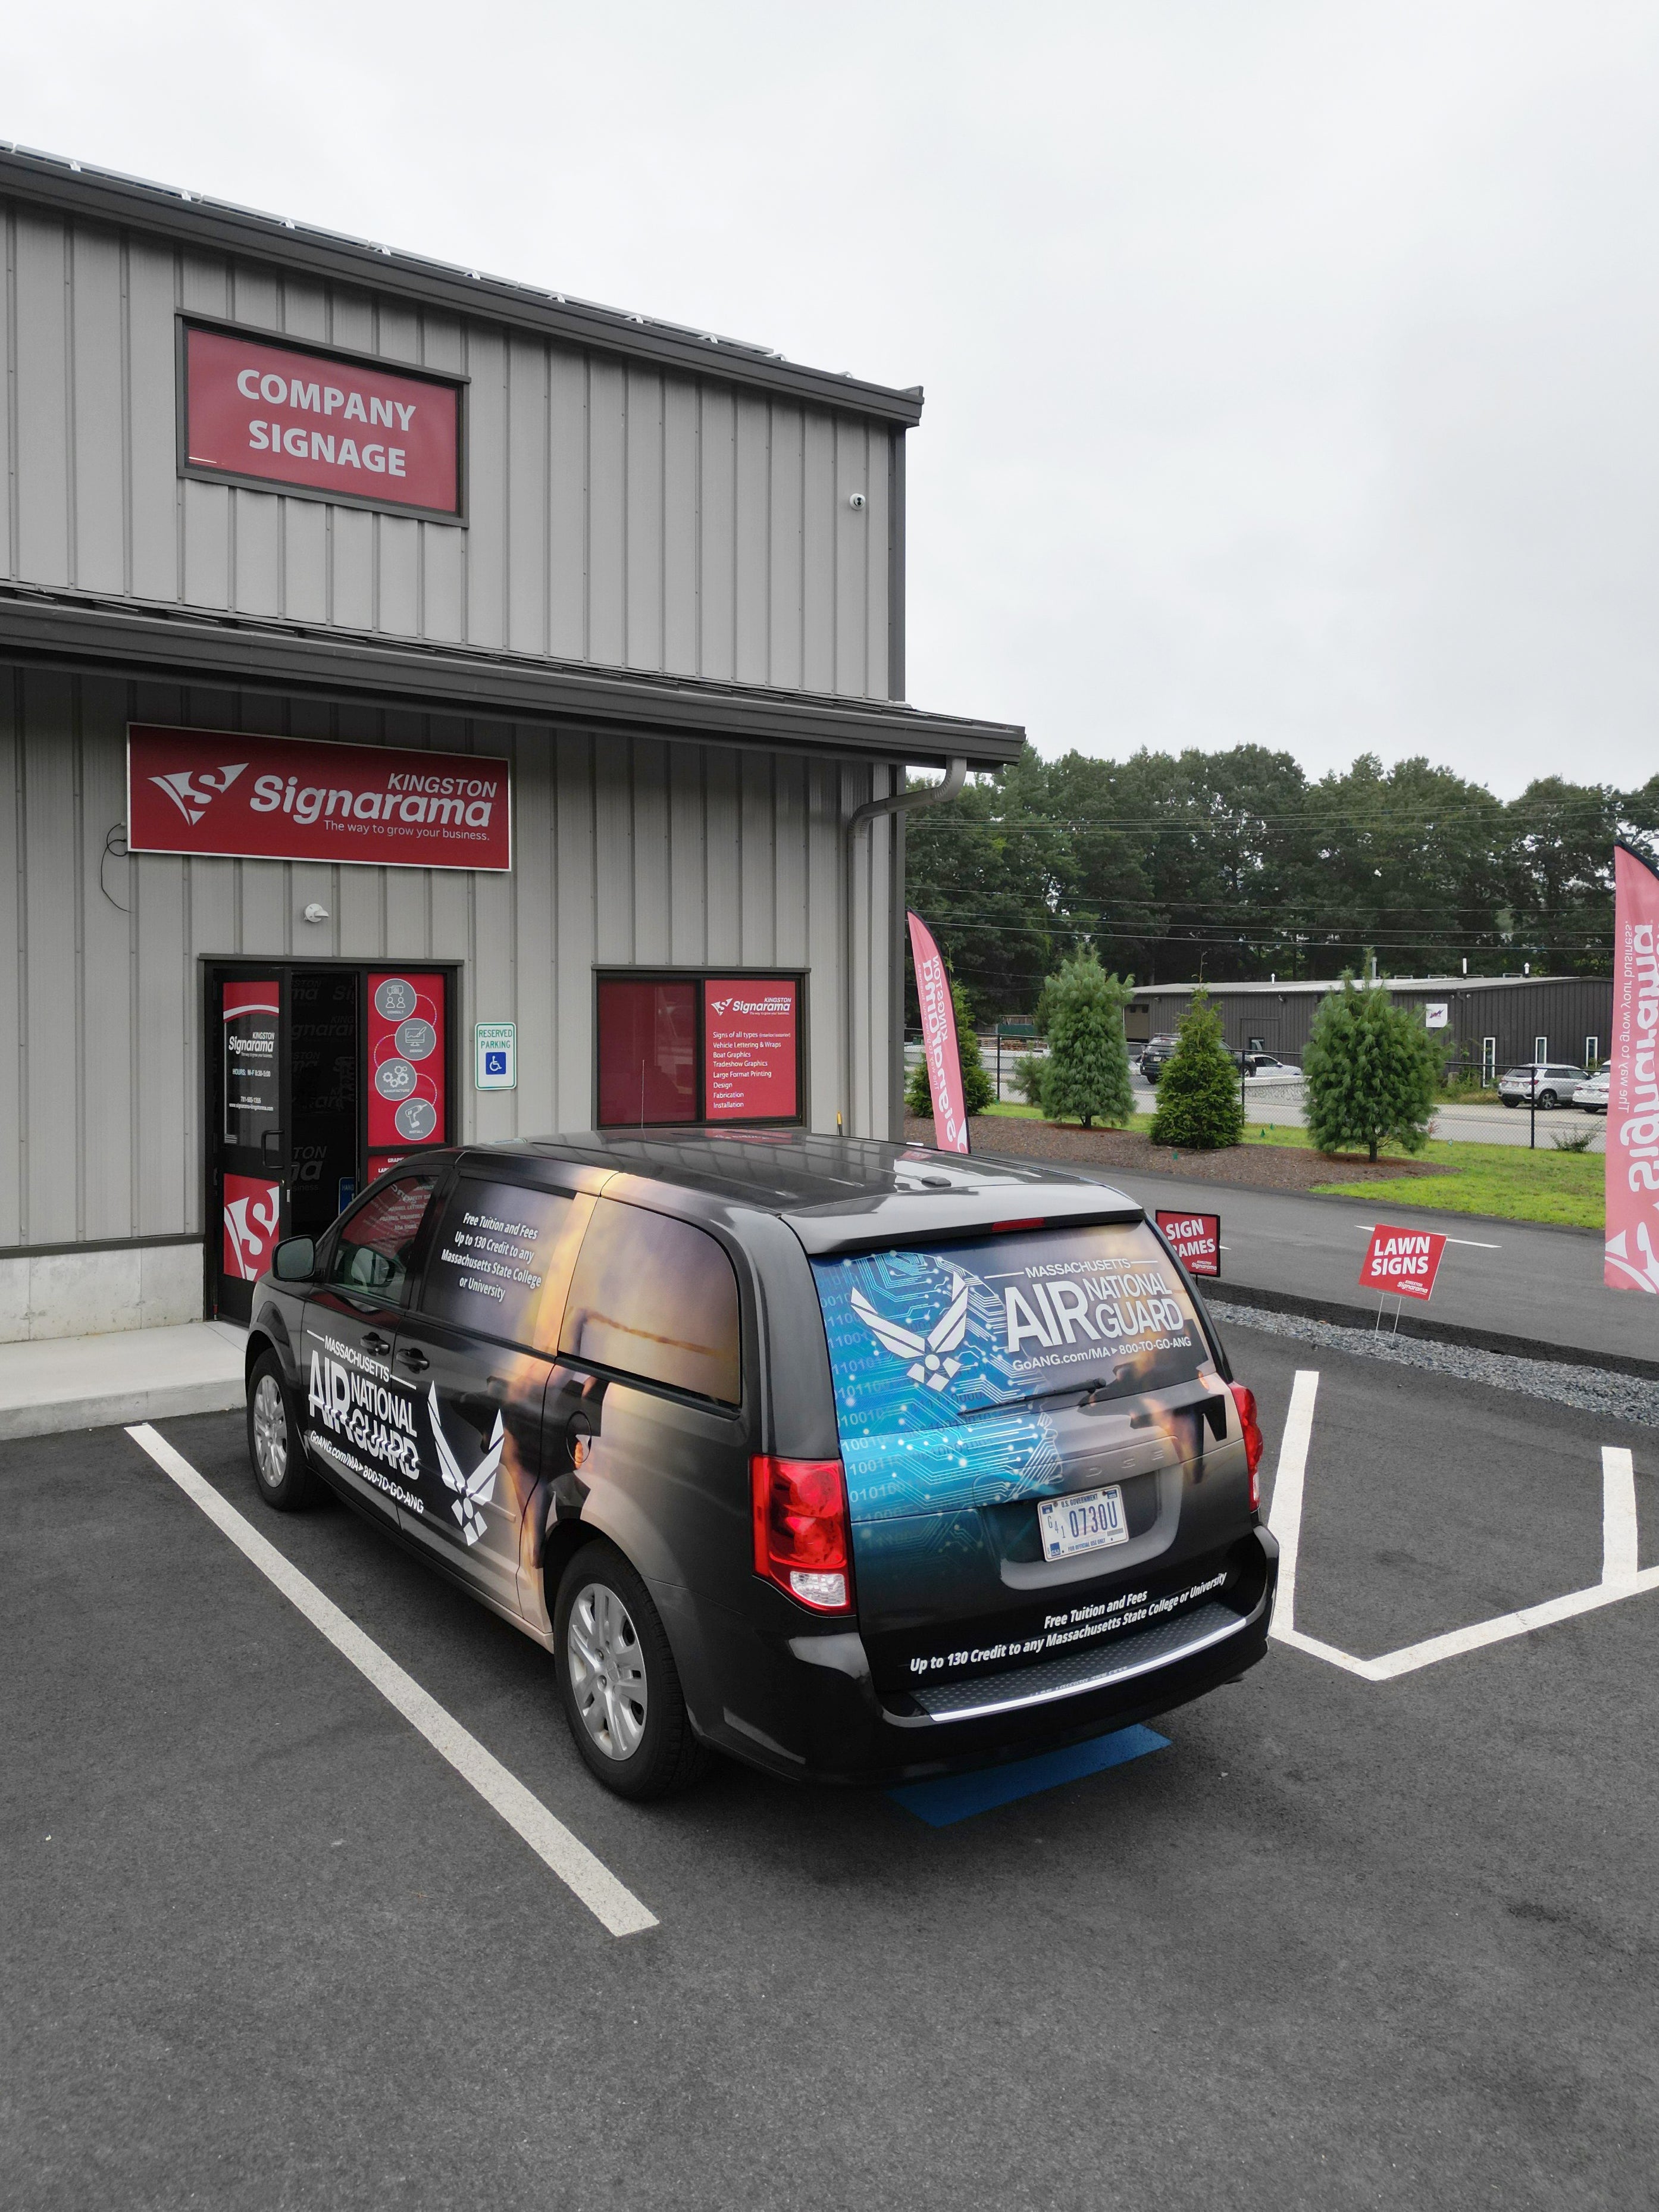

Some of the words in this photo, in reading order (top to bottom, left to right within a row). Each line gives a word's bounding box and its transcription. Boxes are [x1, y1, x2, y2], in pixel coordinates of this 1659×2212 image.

[237, 369, 417, 431] COMPANY
[249, 420, 406, 477] SIGNAGE
[249, 775, 494, 827] Signarama
[387, 772, 497, 798] KINGSTON
[324, 820, 345, 831] The
[348, 824, 370, 835] way
[373, 825, 384, 833] to
[387, 826, 414, 837] grow
[416, 829, 440, 838] your
[443, 828, 490, 840] business.
[733, 1000, 790, 1014] Signarama
[228, 1036, 274, 1054] Signarama
[463, 1212, 478, 1226] Free
[480, 1216, 505, 1232] Tuition
[504, 1223, 521, 1235] and
[519, 1224, 539, 1240] Fees
[1166, 1219, 1204, 1240] SIGN
[455, 1231, 466, 1247] Up
[465, 1234, 473, 1246] to
[474, 1235, 487, 1249] 130
[487, 1239, 509, 1255] Credit
[510, 1244, 518, 1257] to
[518, 1249, 534, 1265] any
[1172, 1238, 1215, 1257] AMES
[1374, 1237, 1431, 1256] LAWN
[441, 1249, 492, 1273] Massachusetts
[492, 1262, 512, 1278] State
[513, 1268, 542, 1290] College
[1025, 1258, 1131, 1278] MASSACHUSETTS
[1371, 1256, 1429, 1276] SIGNS
[459, 1277, 468, 1288] or
[468, 1277, 506, 1303] University
[1082, 1273, 1173, 1301] NATIONAL
[1004, 1281, 1101, 1353] AIR
[1095, 1298, 1184, 1338] GUARD
[324, 1335, 390, 1382] MASSACHUSETTS
[1012, 1346, 1110, 1372] GoANG.com/MA
[1119, 1337, 1192, 1355] 800-TO-GO-ANG
[308, 1350, 355, 1443] AIR
[351, 1372, 417, 1438] NATIONAL
[350, 1409, 420, 1480] GUARD
[310, 1430, 359, 1471] GoANG.com/MA
[362, 1465, 424, 1514] 800-TO-GO-ANG
[1070, 1494, 1098, 1506] GOVERNMENT
[1069, 1501, 1118, 1538] 0730U
[910, 1658, 928, 1674] Up
[931, 1657, 944, 1669] to
[947, 1651, 968, 1666] 130
[971, 1644, 1007, 1663] Credit
[1009, 1643, 1021, 1656] to
[1023, 1638, 1045, 1653] any
[1046, 1616, 1122, 1647] Massachusetts
[1122, 1609, 1147, 1626] State
[1148, 1595, 1179, 1616] College
[1179, 1591, 1190, 1603] or
[1190, 1572, 1228, 1598] University
[1044, 1615, 1067, 1629] Free
[1070, 1604, 1105, 1623] Tuition
[1107, 1595, 1126, 1612] and
[1126, 1591, 1148, 1607] Fees
